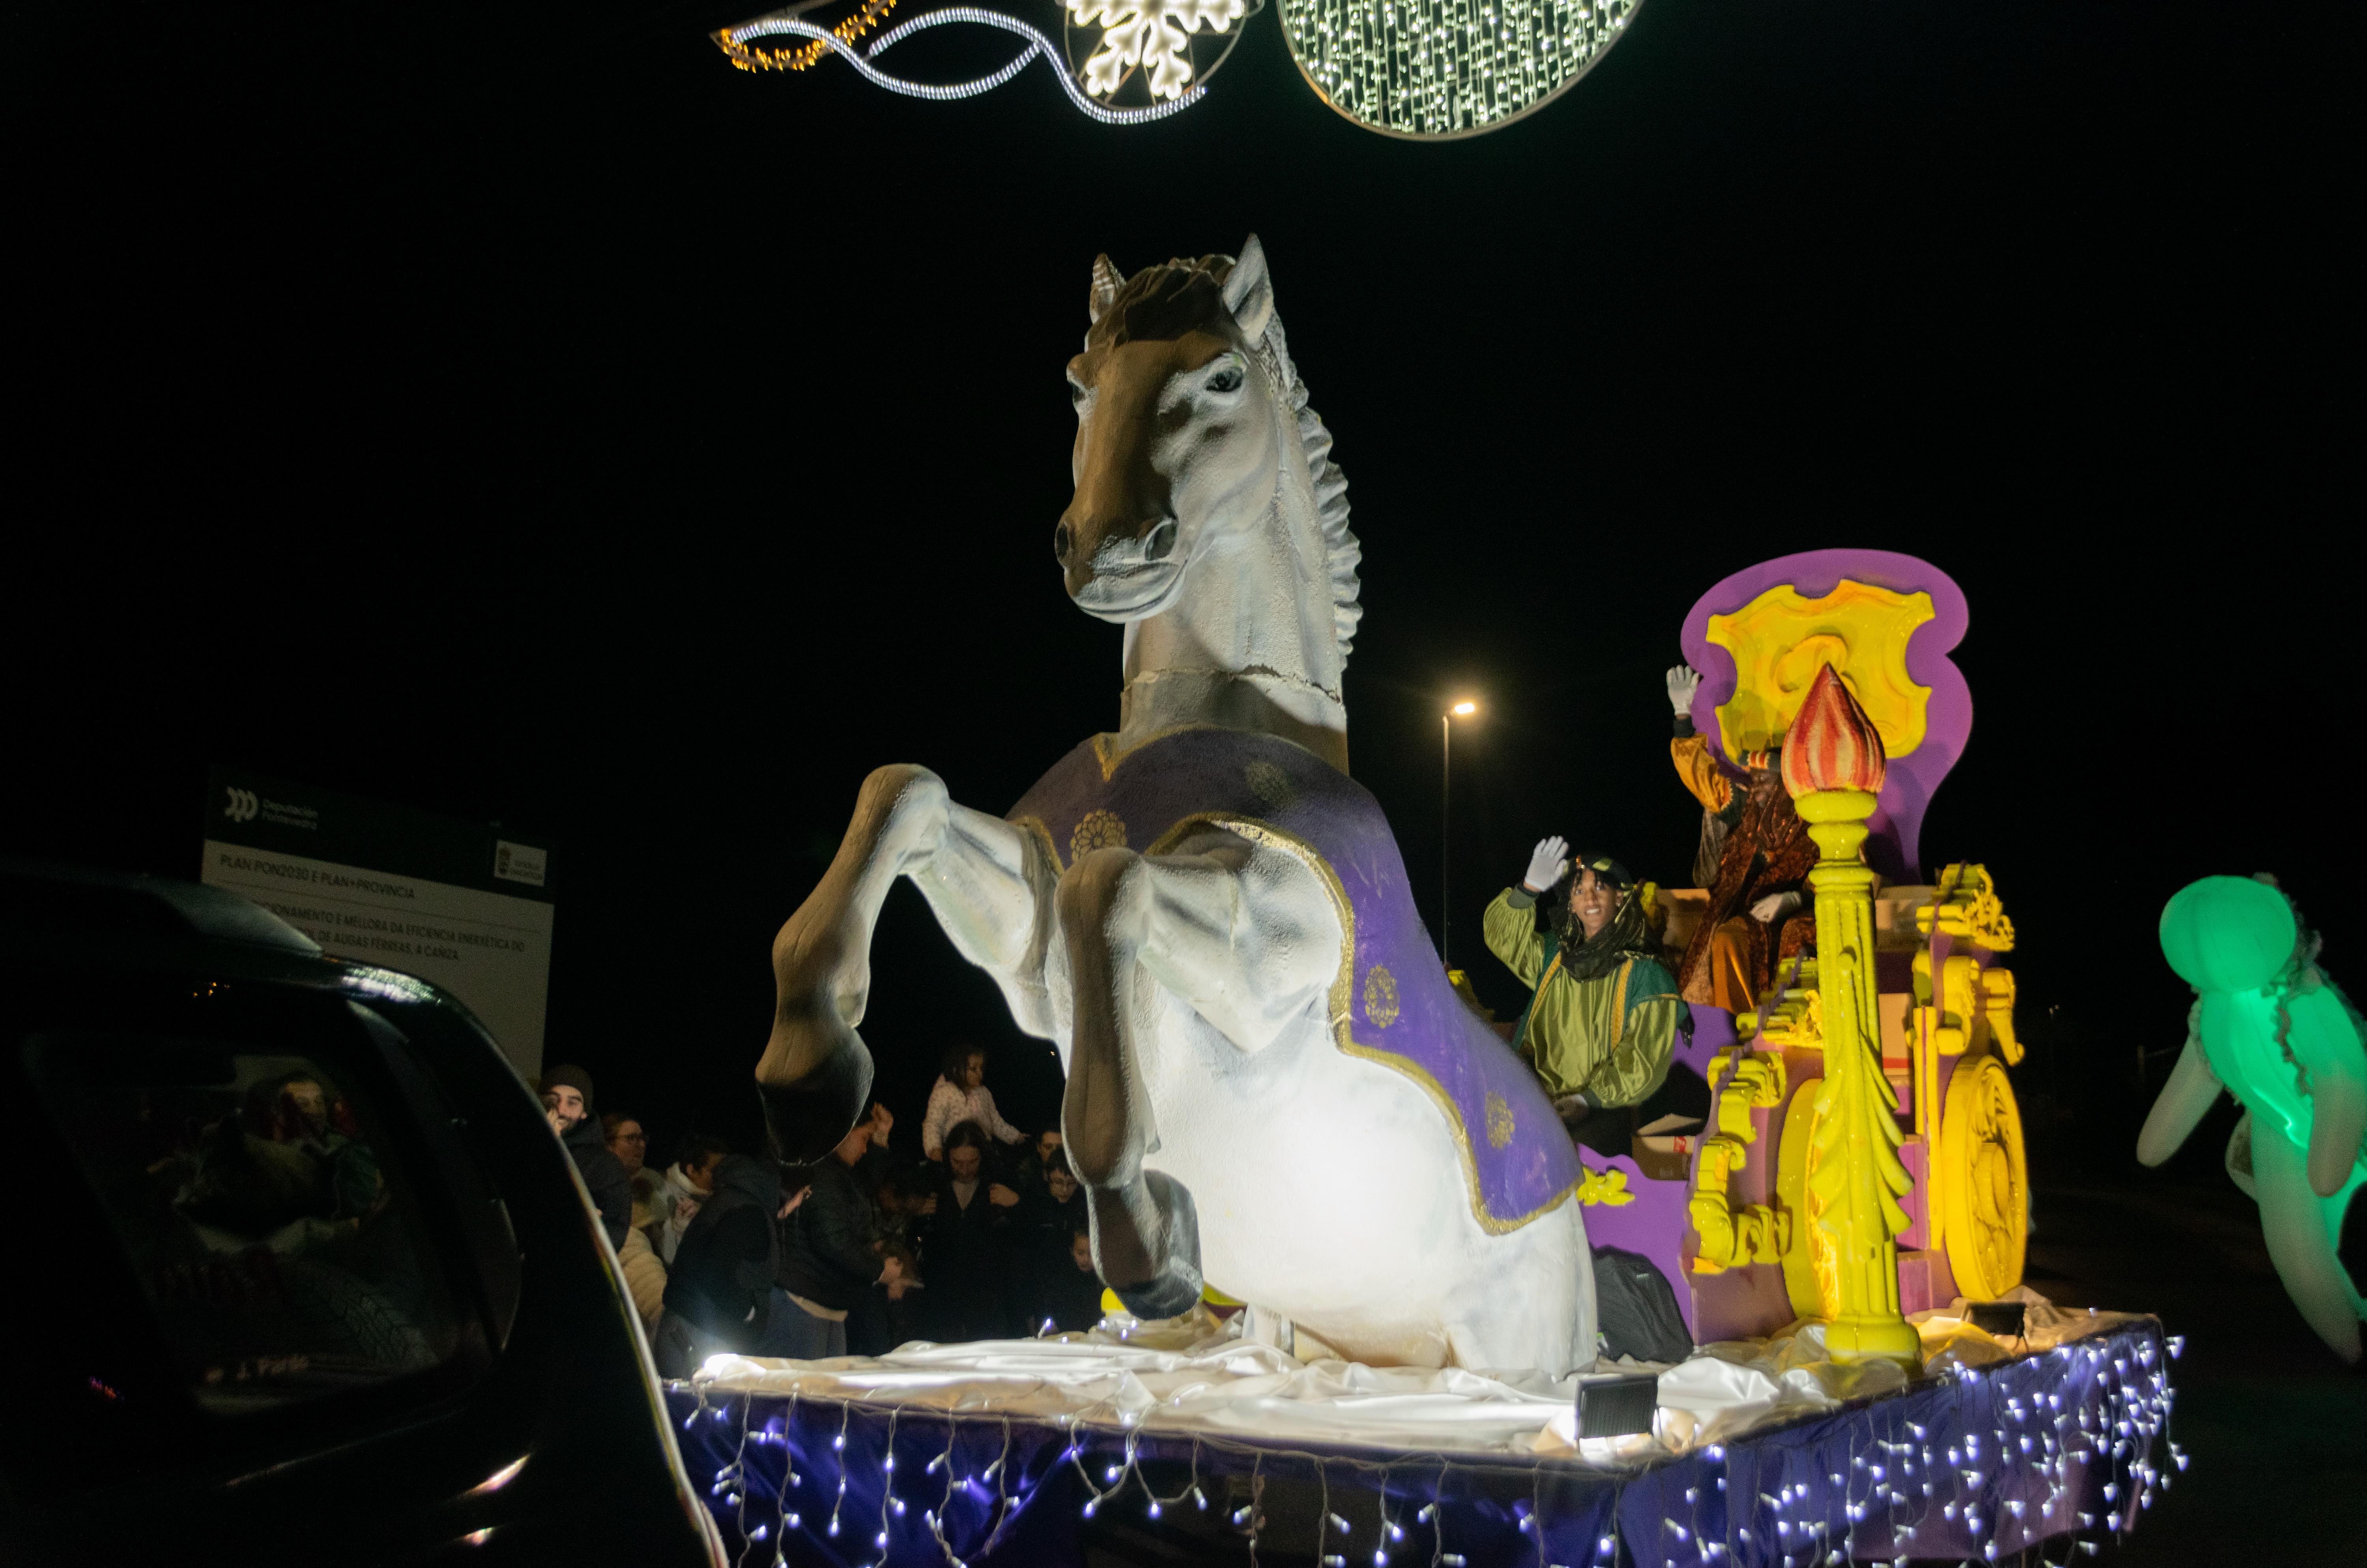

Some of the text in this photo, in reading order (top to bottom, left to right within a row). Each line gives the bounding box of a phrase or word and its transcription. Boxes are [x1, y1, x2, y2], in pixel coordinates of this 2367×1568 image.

[220, 854, 251, 870] PLAN
[254, 860, 309, 880] PON2030
[312, 871, 318, 883] E
[318, 930, 331, 943] DE
[334, 933, 369, 948] AUGAS
[415, 944, 423, 955] A
[336, 913, 341, 925] E
[344, 915, 388, 931] MELLORA
[391, 922, 404, 934] DA
[406, 924, 456, 942] EFICIENCIA
[511, 939, 525, 953] DO
